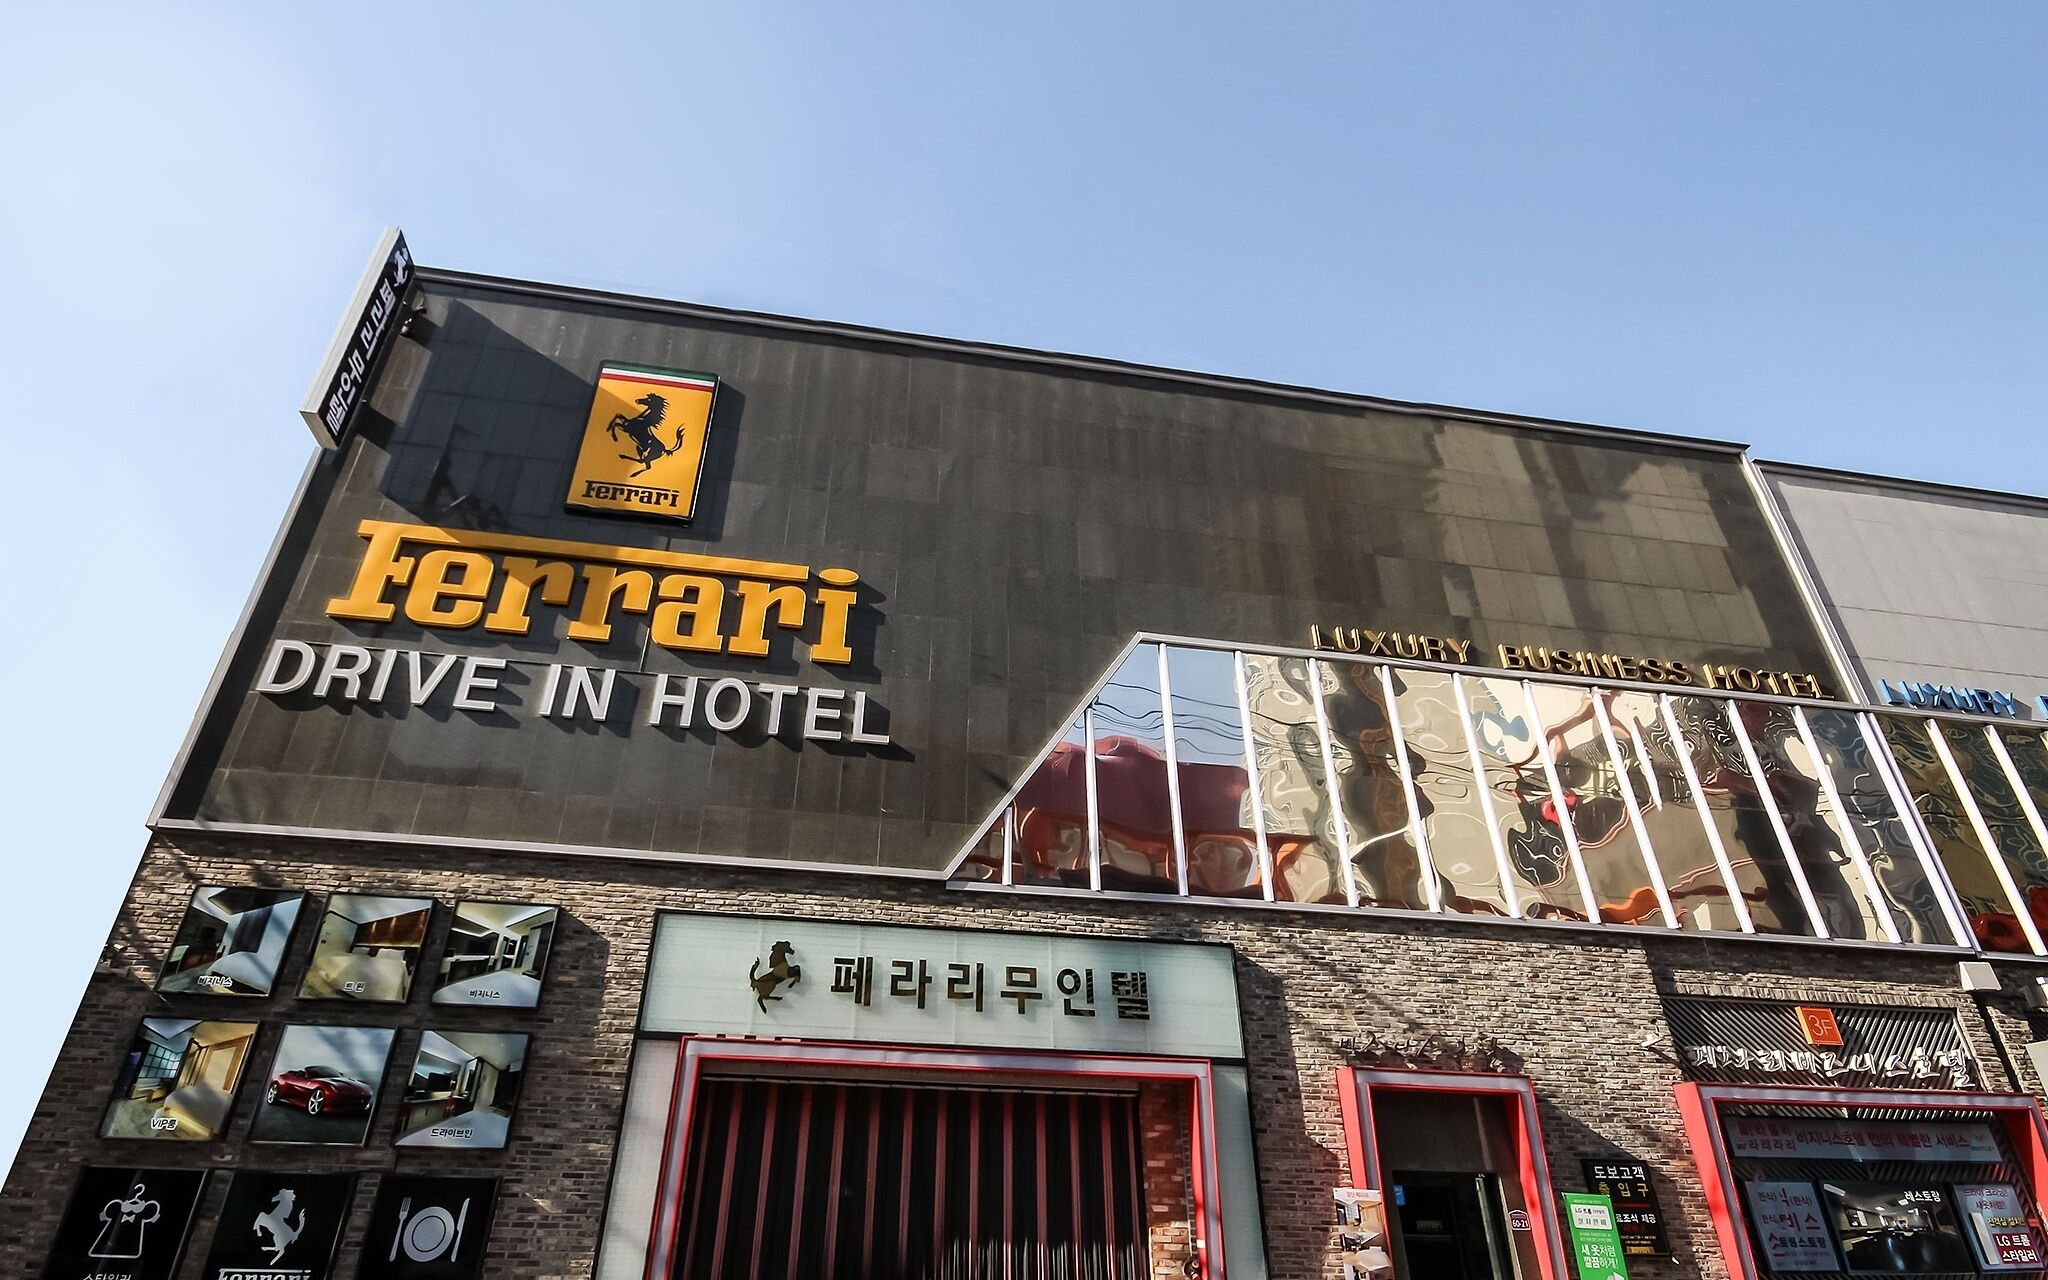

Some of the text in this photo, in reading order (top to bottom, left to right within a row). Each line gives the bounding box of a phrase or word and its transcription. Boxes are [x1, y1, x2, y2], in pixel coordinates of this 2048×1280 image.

[582, 480, 679, 510] Ferrari
[325, 519, 860, 664] Ferrari
[1310, 623, 1833, 699] LUXURY BUSINESS HOTEL
[255, 638, 890, 745] DRIVE IN HOTEL
[1877, 678, 2016, 716] LUXURY
[469, 989, 501, 999] 비지니스
[830, 955, 1151, 1021] 페라리무인텔
[1807, 1013, 1836, 1037] 3F
[430, 1128, 473, 1139] 드라이브인
[1594, 1165, 1646, 1181] 도보고객
[1903, 1190, 1941, 1203] 레스토랑
[1996, 1234, 2031, 1247] LG 트롬
[2003, 1248, 2038, 1262] 스타일러
